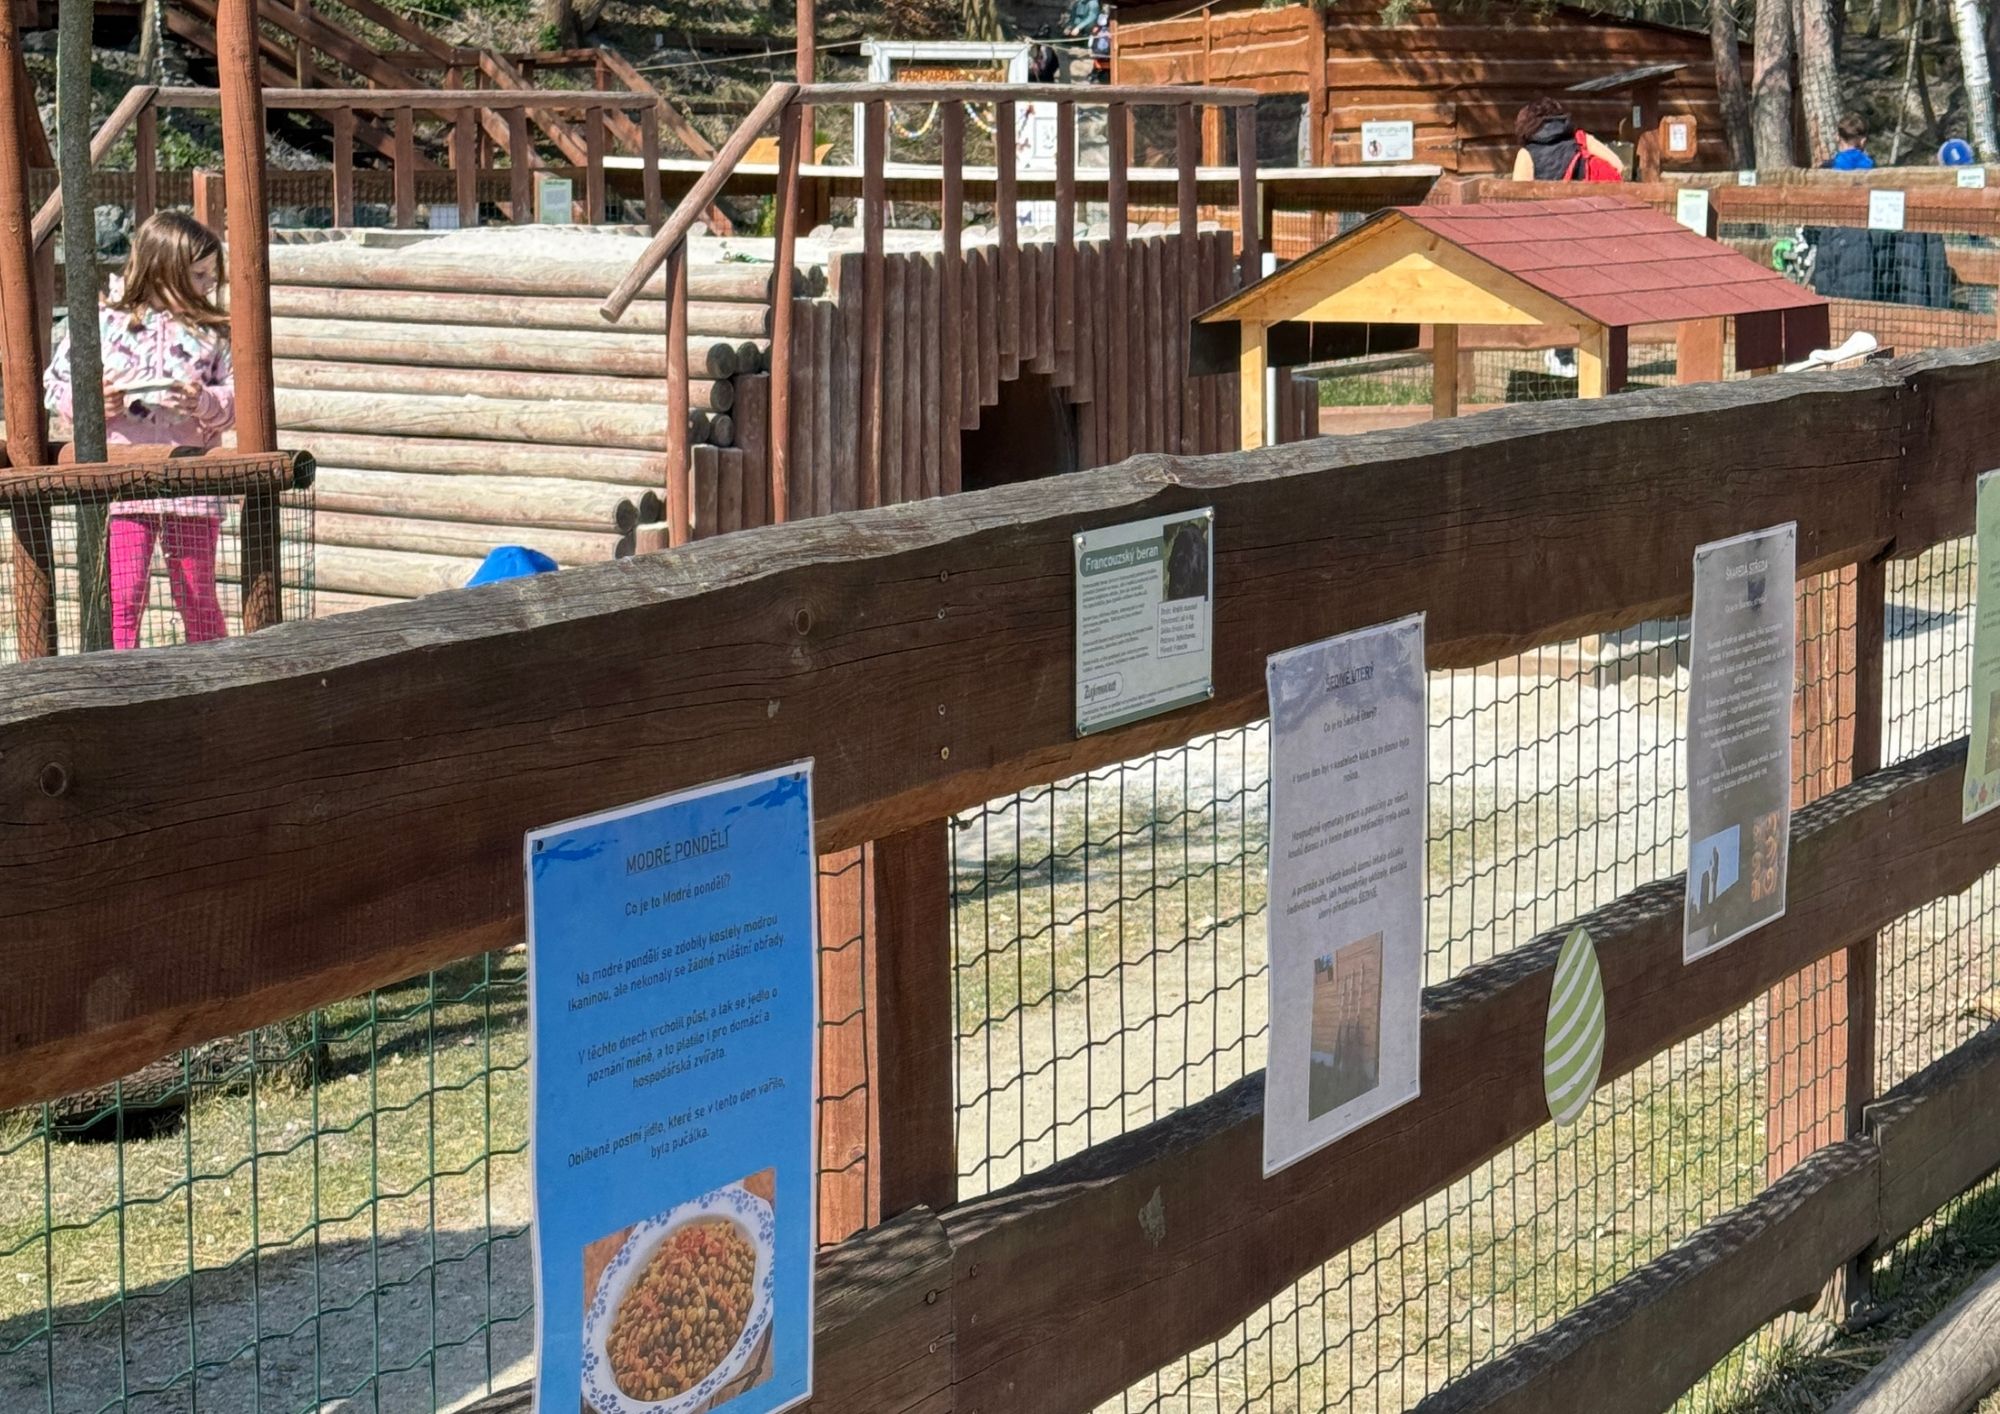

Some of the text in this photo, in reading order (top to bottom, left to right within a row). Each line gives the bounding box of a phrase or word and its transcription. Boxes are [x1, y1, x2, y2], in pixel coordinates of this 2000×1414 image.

[1085, 545, 1159, 571] Francouzský beran
[1350, 661, 1375, 684] ÚTERÝ
[626, 828, 730, 874] MODRÉ PONDĚLÍ
[625, 873, 731, 916] Co je to Modré pondělí?
[577, 914, 778, 987] Na modré pondělí se zdobily kostely modrou
[568, 989, 611, 1012] tkaninou,
[614, 983, 628, 998] ale
[630, 967, 672, 990] nekonaly
[674, 965, 685, 977] se
[687, 952, 715, 973] žádné
[717, 943, 751, 964] zvláštní
[578, 1051, 585, 1064] V
[587, 1040, 617, 1061] těchto
[619, 1028, 648, 1053] dnech
[650, 1020, 685, 1039] vrcholil
[711, 1007, 717, 1018] a
[718, 1001, 733, 1016] tak
[734, 998, 746, 1009] se
[747, 990, 770, 1010] jedlo
[772, 988, 778, 998] o
[587, 1058, 625, 1087] poznání
[657, 1048, 663, 1058] a
[665, 1042, 674, 1055] to
[676, 1033, 705, 1057] platilo
[712, 1026, 728, 1042] pro
[729, 1012, 763, 1033] domácí
[764, 1011, 770, 1021] a
[633, 1059, 692, 1089] hospodářská
[568, 1139, 610, 1168] Oblíbené
[613, 1129, 642, 1154] postní
[668, 1106, 692, 1129] které
[693, 1107, 705, 1119] se
[707, 1104, 713, 1114] v
[715, 1095, 738, 1111] tento
[740, 1086, 756, 1101] den
[651, 1142, 669, 1159] byla
